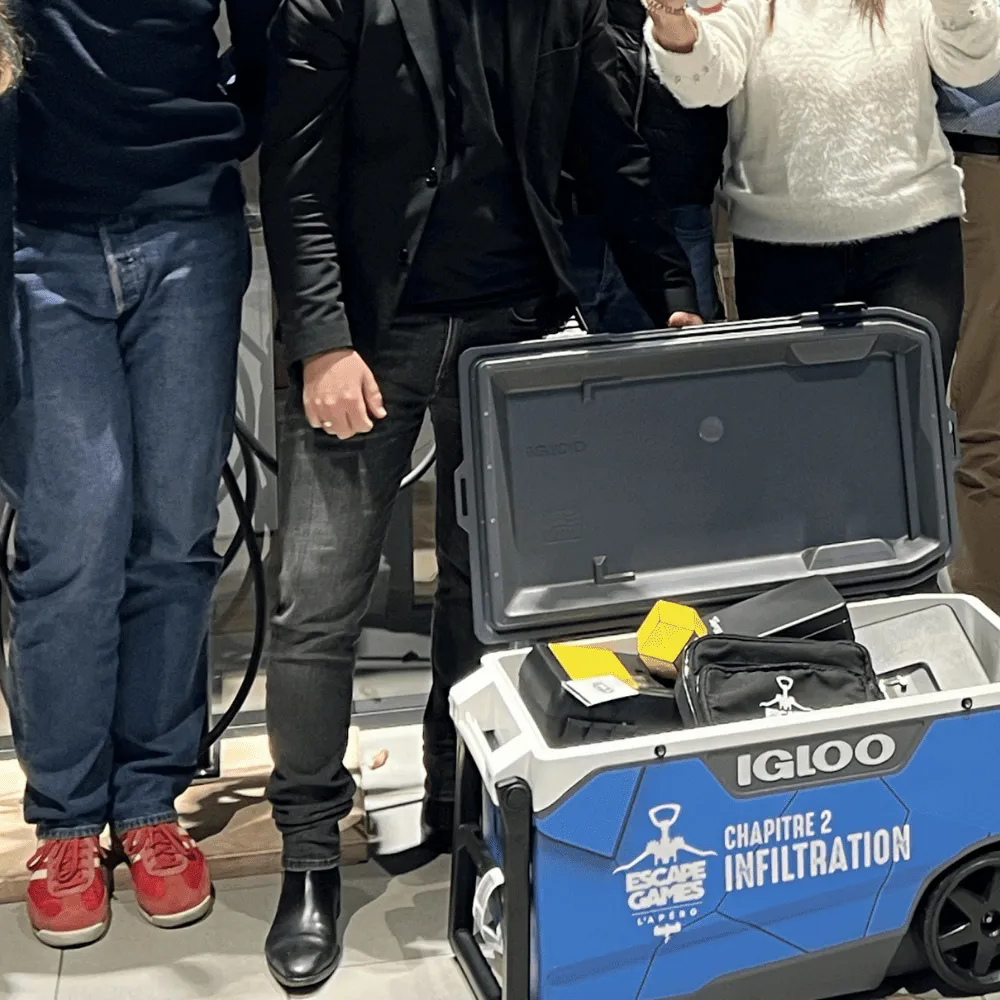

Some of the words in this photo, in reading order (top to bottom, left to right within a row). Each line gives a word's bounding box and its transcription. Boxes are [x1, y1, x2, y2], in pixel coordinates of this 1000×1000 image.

[737, 733, 896, 787] IGLOO
[724, 811, 815, 850] CHAPITRE
[820, 809, 833, 835] 2
[626, 860, 707, 893] ESCAPE
[724, 823, 911, 892] INFILTRATION
[628, 880, 705, 911] GAMES
